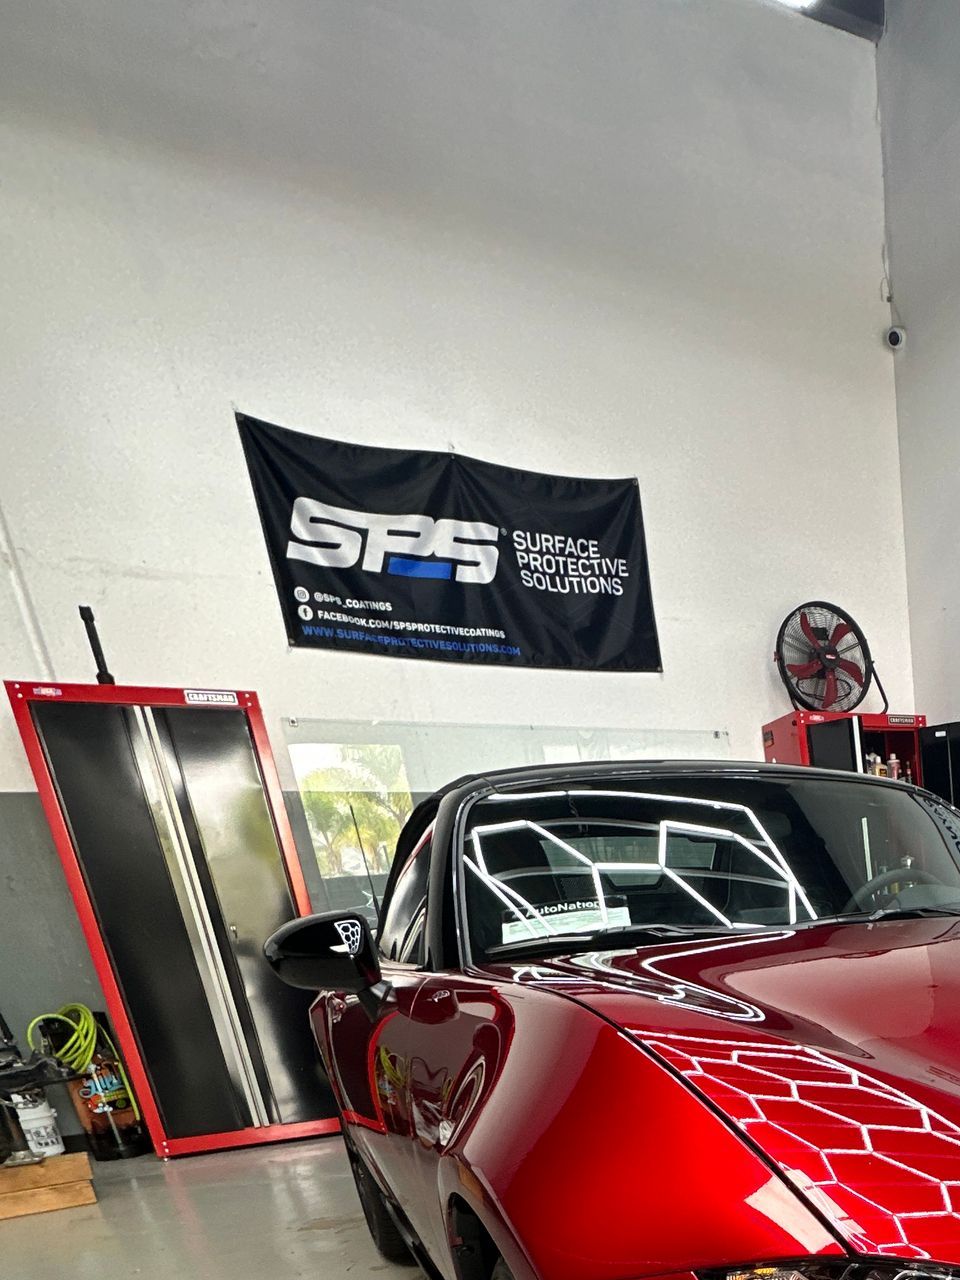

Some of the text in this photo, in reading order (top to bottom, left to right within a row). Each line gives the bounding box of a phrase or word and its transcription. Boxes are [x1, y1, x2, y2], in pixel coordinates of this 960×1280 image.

[286, 496, 500, 585] SPS
[512, 530, 600, 558] SURFACE
[516, 551, 629, 578] PROTECTIVE
[521, 570, 623, 596] SOLUTIONS
[313, 591, 393, 612] @SPS_COATINGS
[317, 610, 506, 639] FACEBOOK.COM/SPSPROTECTIVECOATINGS
